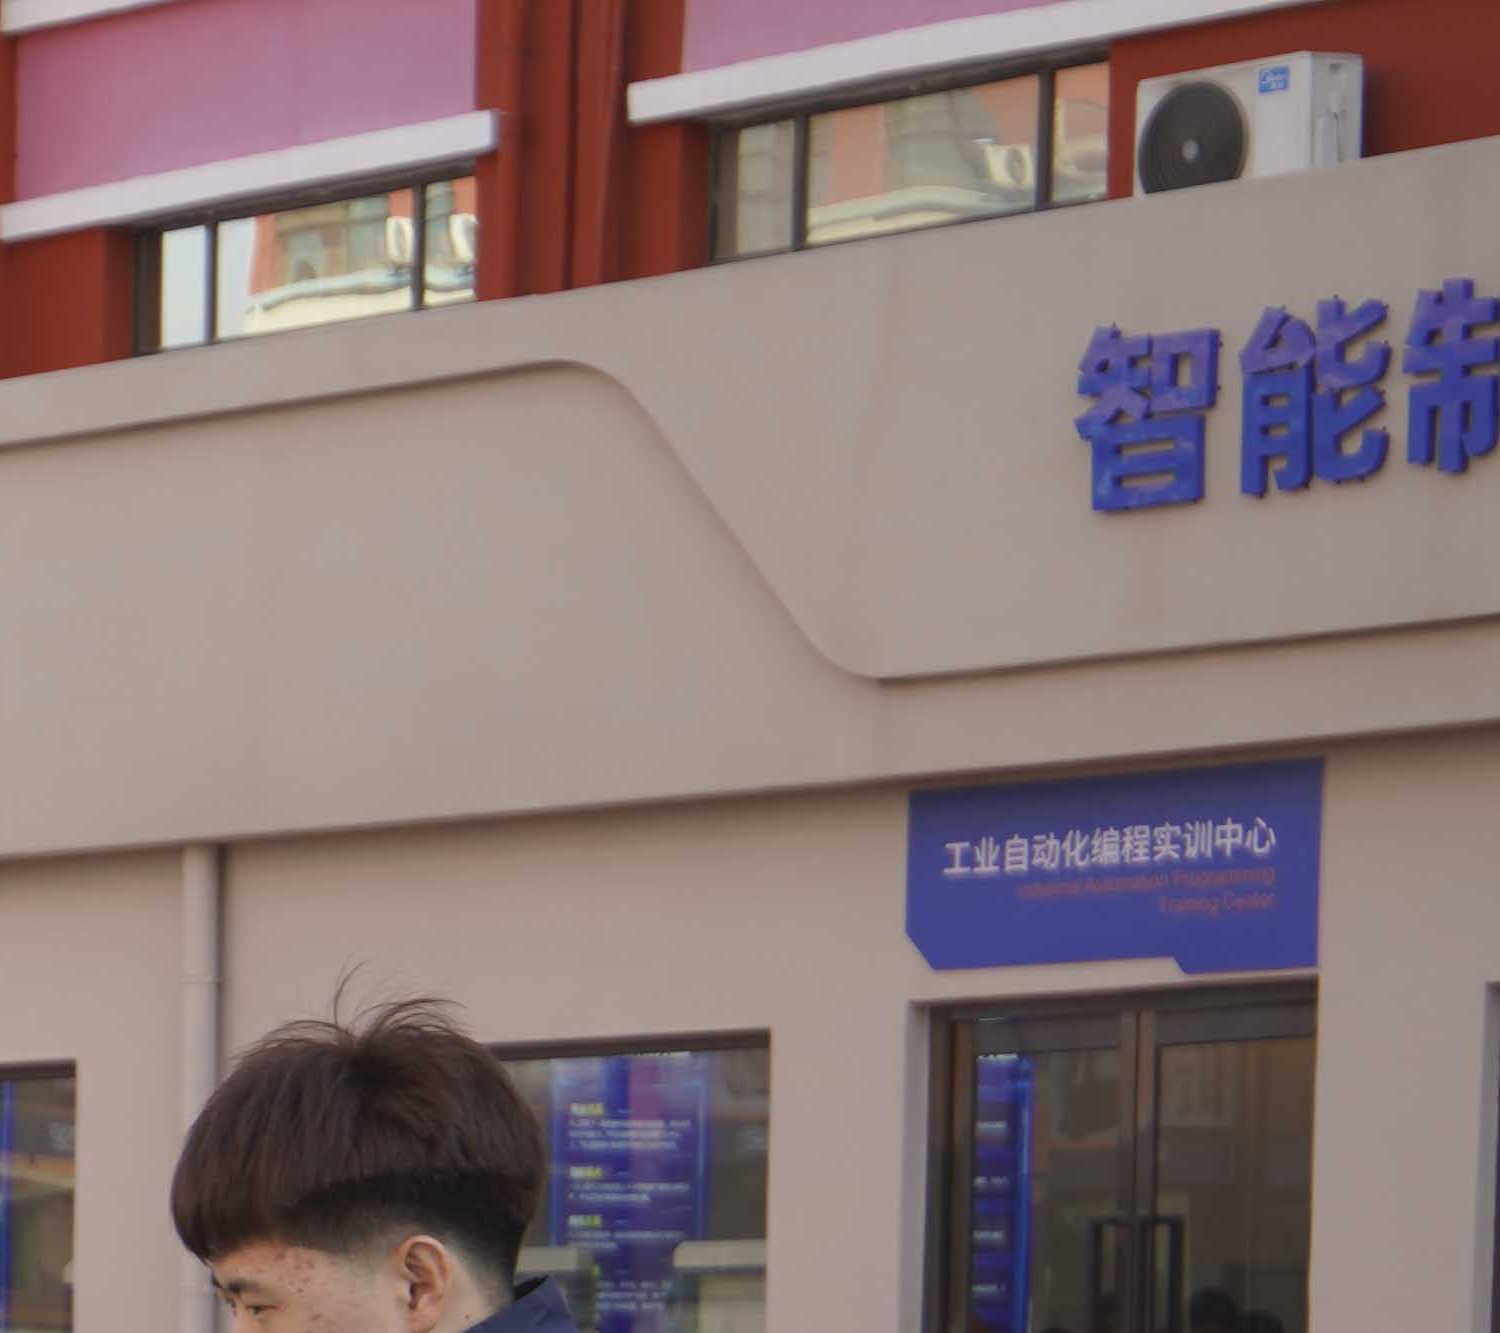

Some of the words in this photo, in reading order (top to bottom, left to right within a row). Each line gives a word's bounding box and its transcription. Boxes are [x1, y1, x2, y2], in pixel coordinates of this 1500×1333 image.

[943, 817, 1276, 877] 工业自动化编程实训中心
